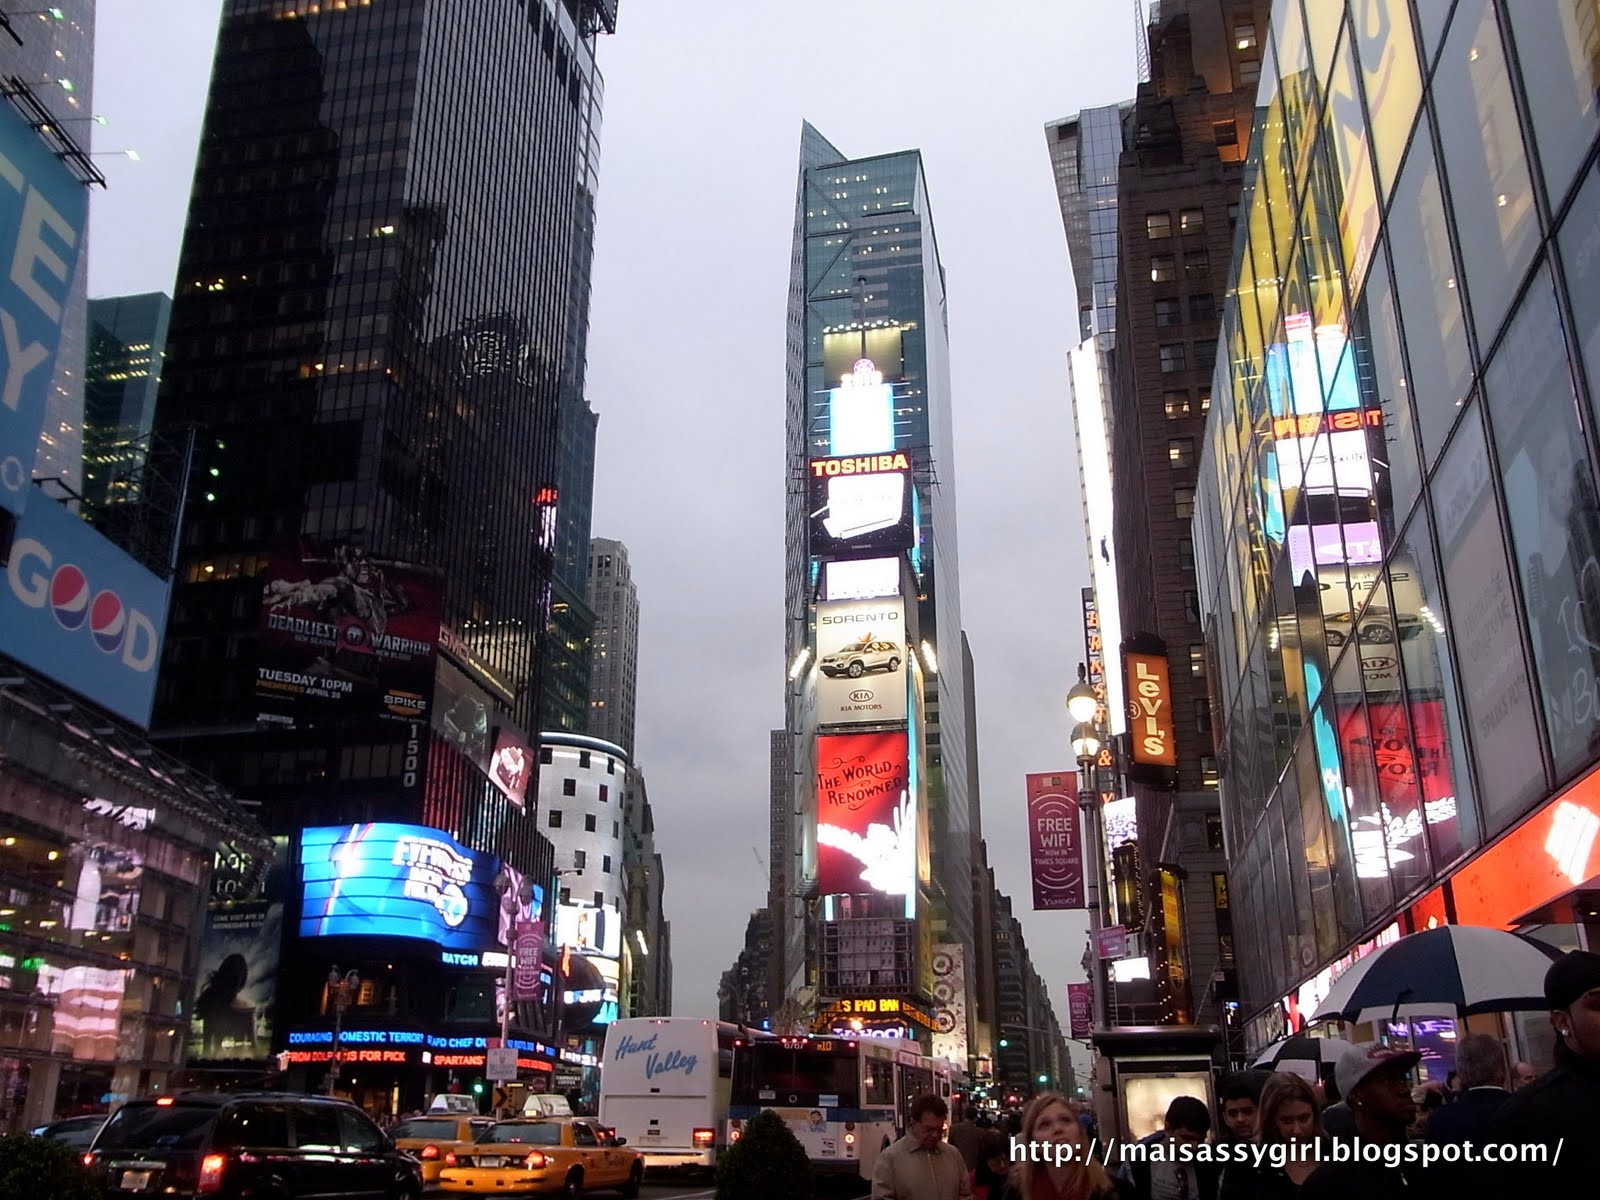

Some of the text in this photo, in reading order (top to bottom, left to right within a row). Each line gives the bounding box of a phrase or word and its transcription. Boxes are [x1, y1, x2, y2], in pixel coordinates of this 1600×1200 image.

[811, 453, 908, 477] TOSHIBA
[268, 613, 338, 639] DEADLIEST
[822, 612, 898, 625] SORENTO
[371, 631, 431, 656] WARRIOR
[258, 667, 353, 693] TUESDAY 10PM
[305, 687, 330, 698] APRIL
[853, 692, 870, 700] KIA
[383, 694, 427, 710] SPIKE
[853, 703, 882, 711] MOTORS
[403, 724, 419, 787] 1500
[827, 776, 902, 806] RENOWNED
[1037, 817, 1073, 832] FREE
[1040, 833, 1071, 848] WIFI
[519, 947, 538, 956] FREE
[520, 957, 537, 965] WIFI
[448, 1037, 473, 1048] CHEF
[615, 1033, 657, 1061] Hunt
[359, 1050, 382, 1062] FOR
[383, 1051, 405, 1062] PICK
[646, 1050, 697, 1080] Valley
